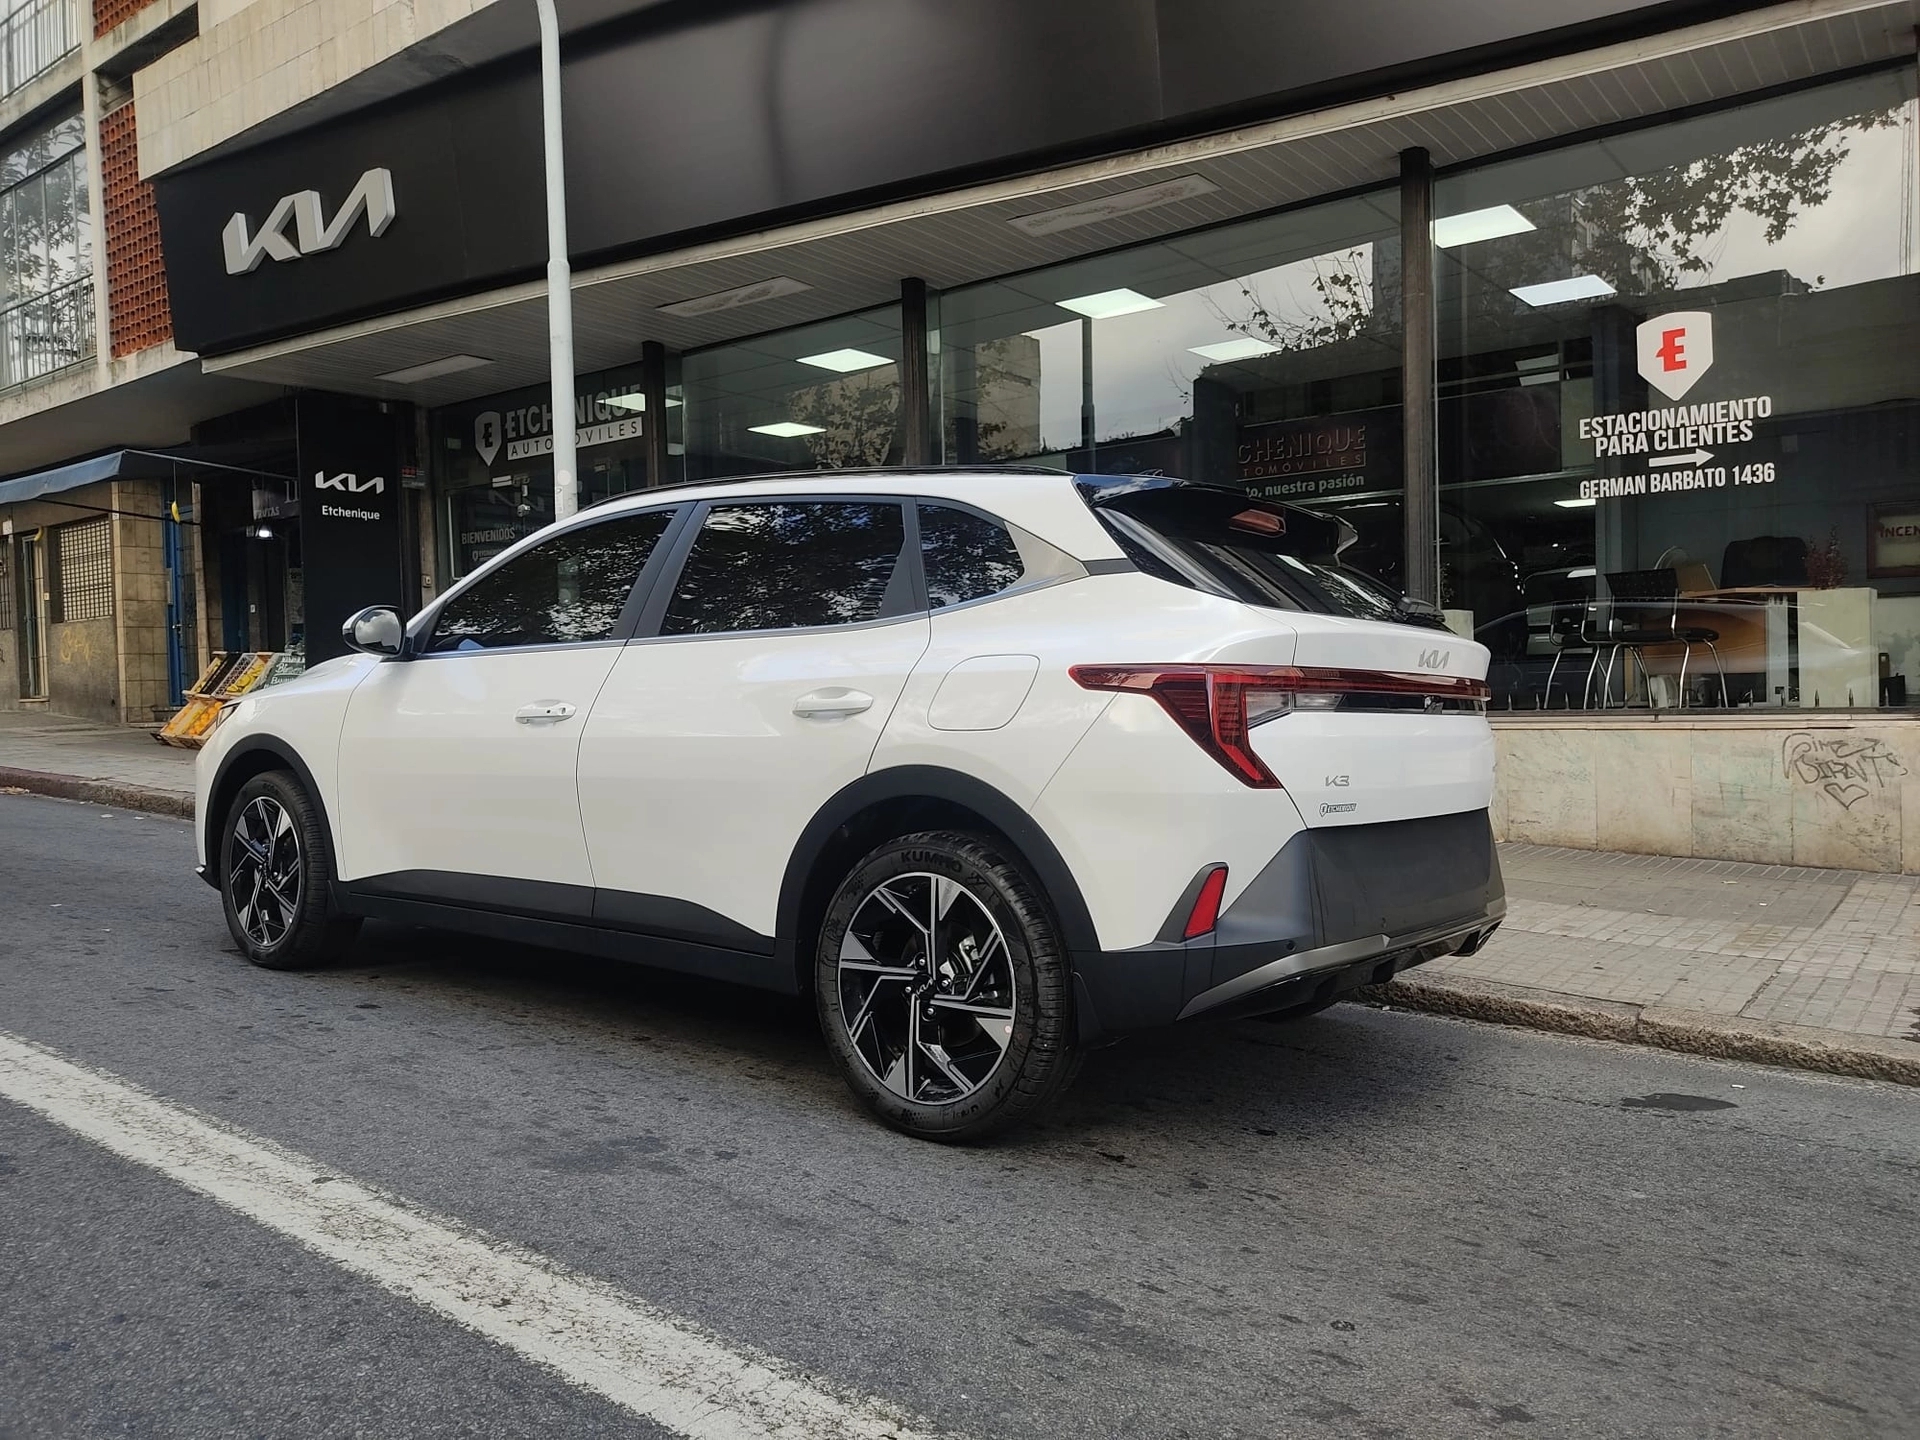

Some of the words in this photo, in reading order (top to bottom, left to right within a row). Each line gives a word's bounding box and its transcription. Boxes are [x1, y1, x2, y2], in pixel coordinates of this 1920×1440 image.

[222, 167, 396, 276] KIA
[1579, 395, 1772, 439] ESTACIONAMIENTO
[1595, 432, 1649, 457] PARA
[1654, 420, 1753, 450] CLIENTES
[315, 470, 385, 494] KIA
[1265, 480, 1315, 497] nuestra
[1319, 473, 1365, 493] pasión
[1579, 474, 1646, 499] GERMAN
[1650, 466, 1726, 493] BARBATO
[1731, 462, 1775, 486] 1436
[322, 505, 380, 521] Etchenique
[461, 527, 516, 545] BIENVENIDOS
[1418, 648, 1450, 669] KIA
[1325, 775, 1350, 787] K3
